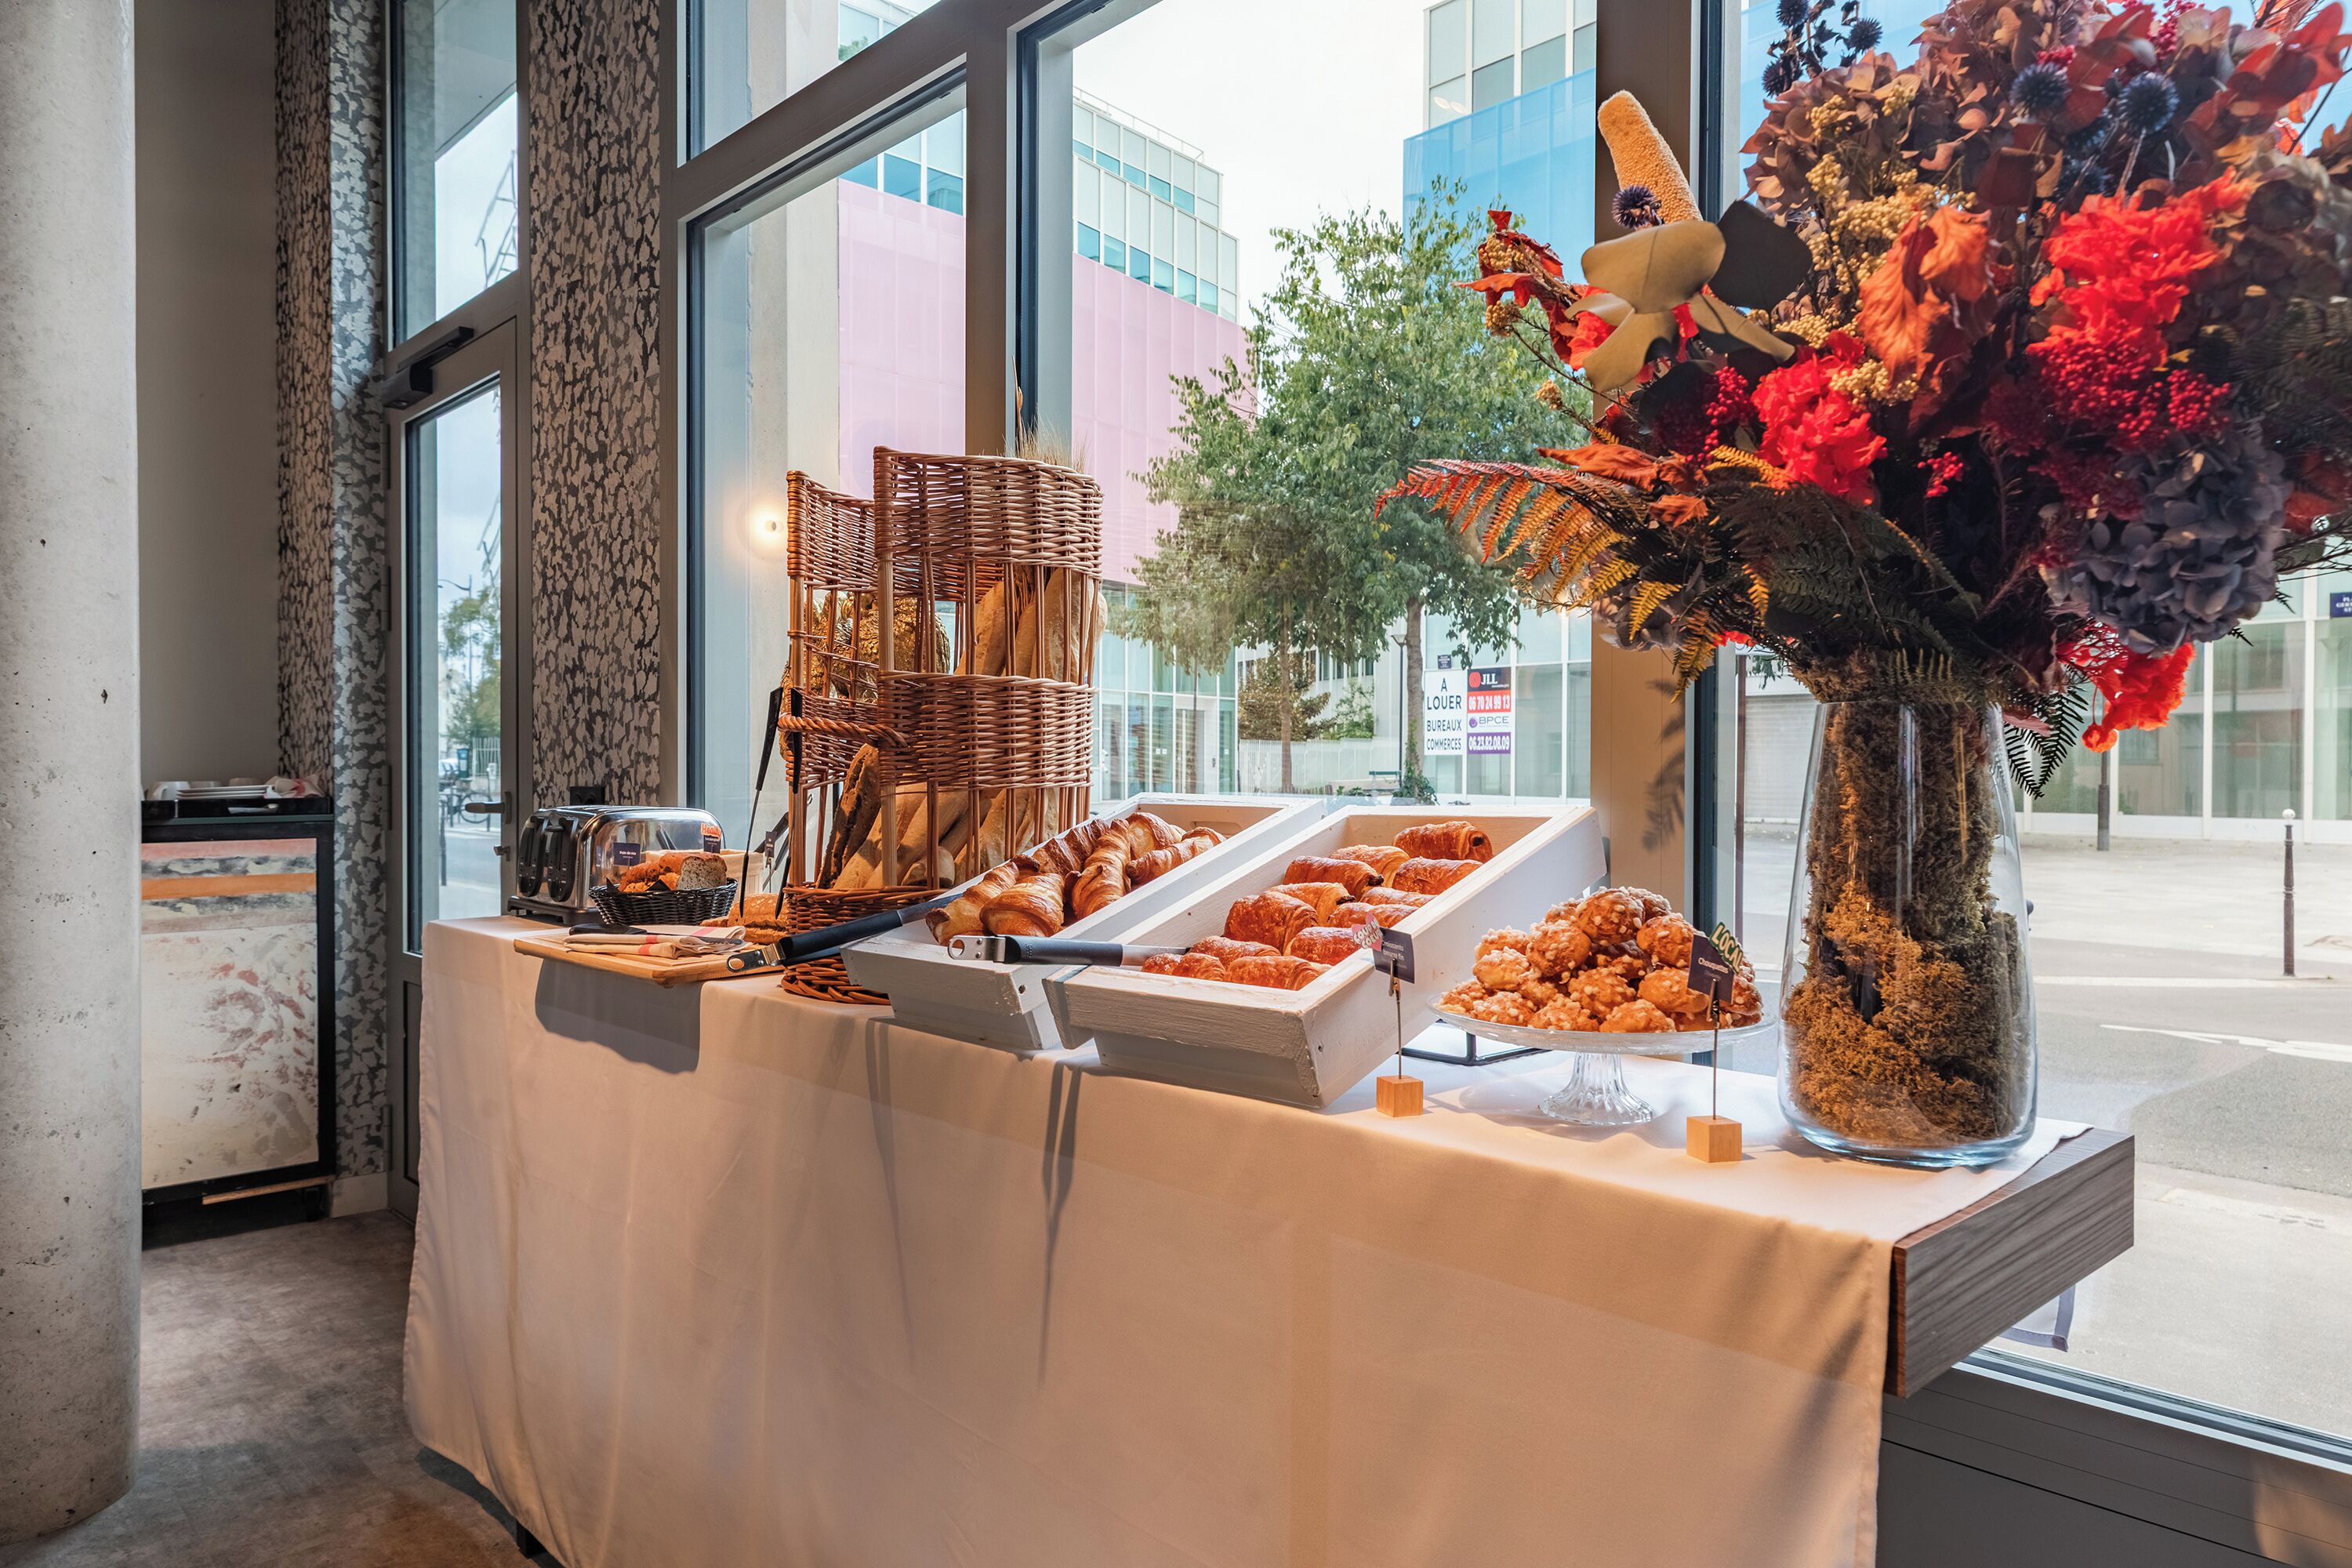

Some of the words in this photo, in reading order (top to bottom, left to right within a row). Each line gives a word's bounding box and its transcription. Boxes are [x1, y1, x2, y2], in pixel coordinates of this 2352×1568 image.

[1441, 677, 1447, 691] A
[1481, 673, 1498, 684] JLL
[1427, 695, 1461, 710] LOUER
[1476, 696, 1484, 710] 70
[1485, 695, 1493, 710] 24
[1502, 694, 1510, 709] 13
[1427, 719, 1461, 731] BUREAUX
[1427, 738, 1461, 750] COMMERCES
[1353, 924, 1372, 943] COUP
[1361, 928, 1384, 949] COEUR
[1711, 924, 1744, 973] LOCAL
